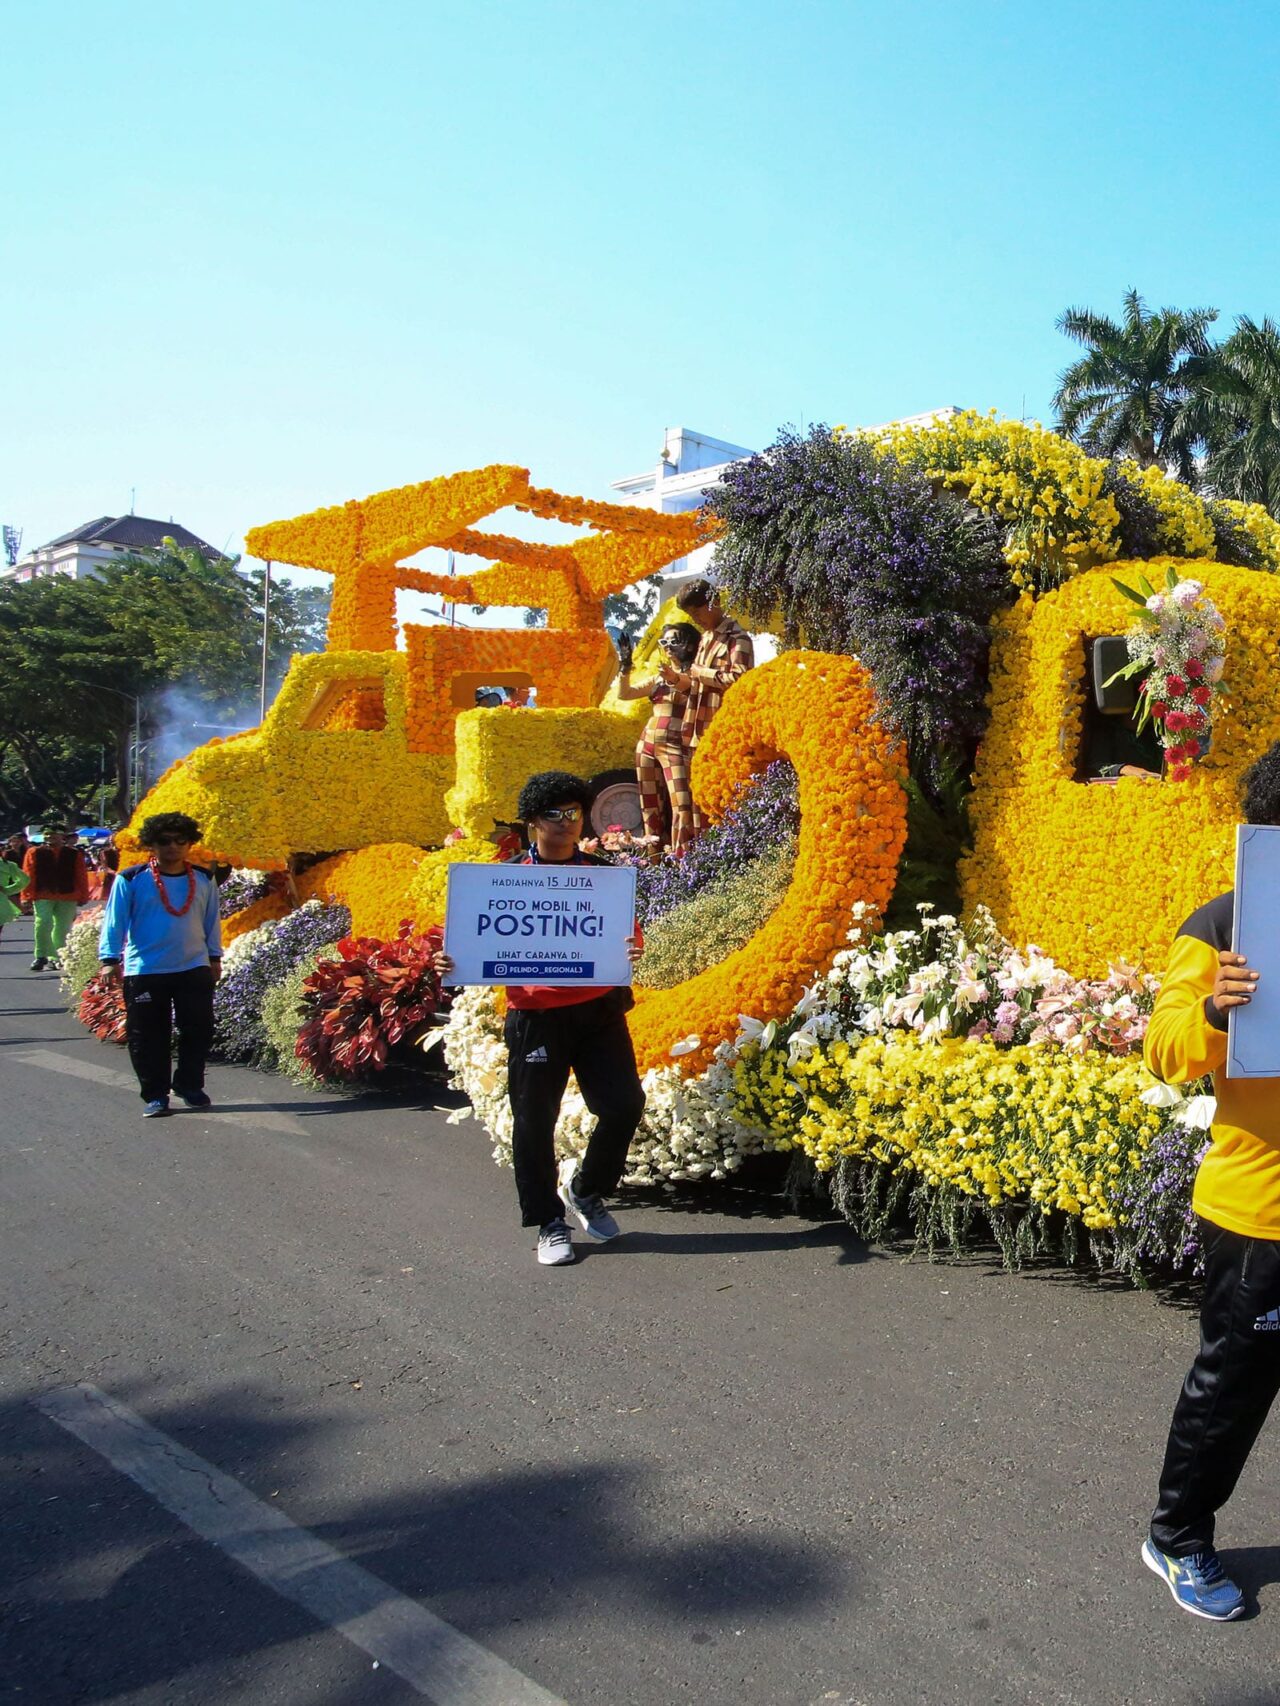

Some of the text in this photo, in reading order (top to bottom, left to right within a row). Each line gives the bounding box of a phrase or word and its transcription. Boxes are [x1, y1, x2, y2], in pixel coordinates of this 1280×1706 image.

[492, 877, 592, 887] HADIAHNYA 15 JUTA
[489, 900, 594, 913] FOTO MOBIL INI,
[477, 914, 603, 937] POSTING!
[497, 951, 583, 959] LIHAT CARANYA DI:
